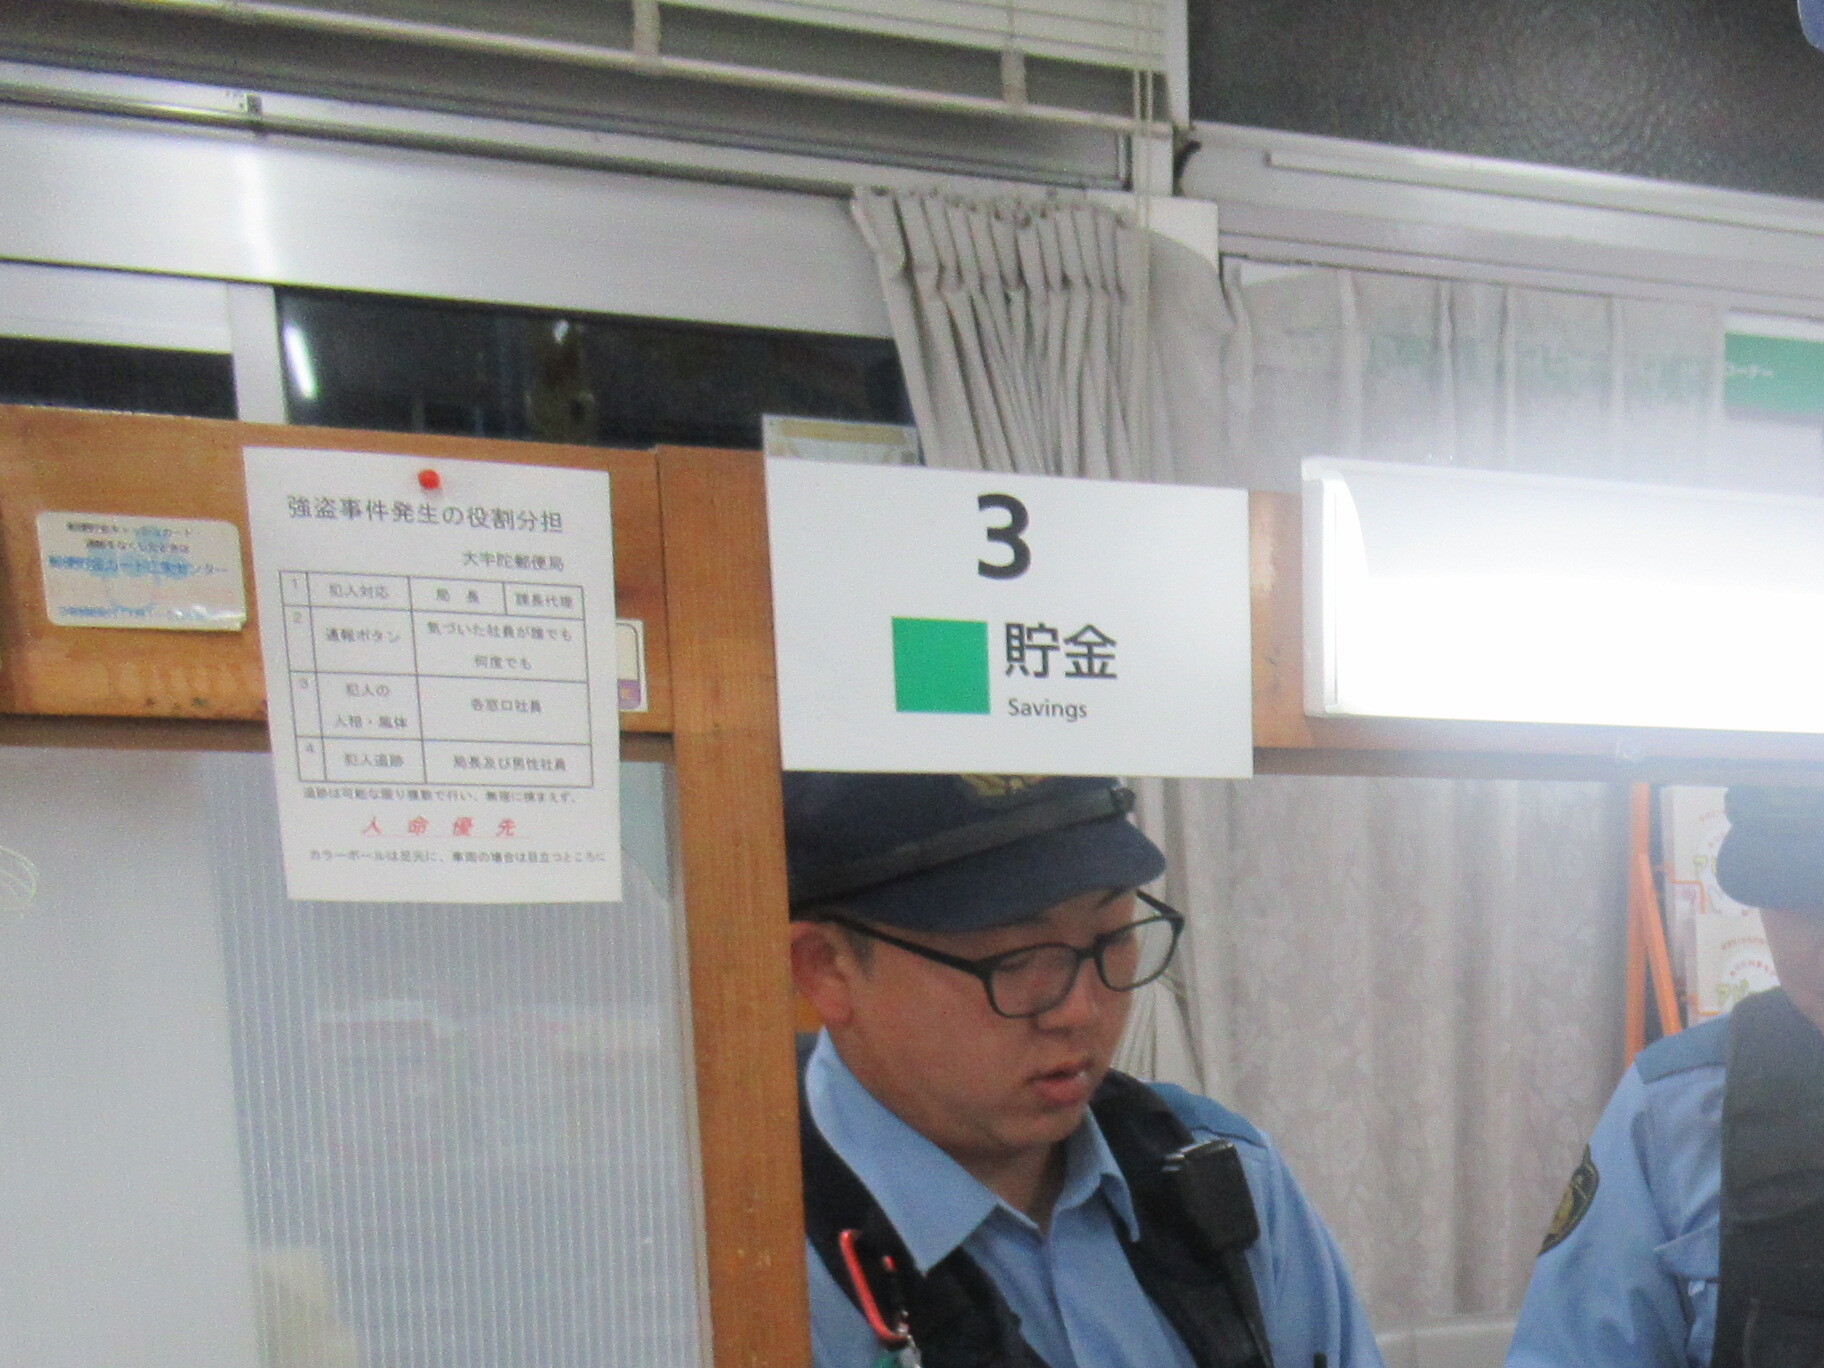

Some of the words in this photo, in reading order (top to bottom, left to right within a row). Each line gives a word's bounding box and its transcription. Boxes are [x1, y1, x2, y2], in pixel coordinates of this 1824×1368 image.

[287, 494, 563, 534] 強盗事件発生の役割分担
[977, 492, 1033, 580] 3
[462, 550, 565, 572] 大宇陀郵便局
[329, 582, 389, 600] 犯人対応
[515, 591, 573, 610] 課長代理
[325, 626, 401, 644] 通報ボタン
[427, 620, 573, 643] 気づいた社員が誰でも
[1004, 622, 1120, 681] 貯金
[474, 655, 533, 670] 何度でも
[345, 683, 390, 698] 犯人の
[470, 697, 544, 714] 各窓口社員
[1007, 696, 1090, 722] Savings
[334, 714, 408, 730] 人相・風体
[344, 753, 405, 769] 犯人追跡
[453, 754, 567, 773] 局長及び男性社員
